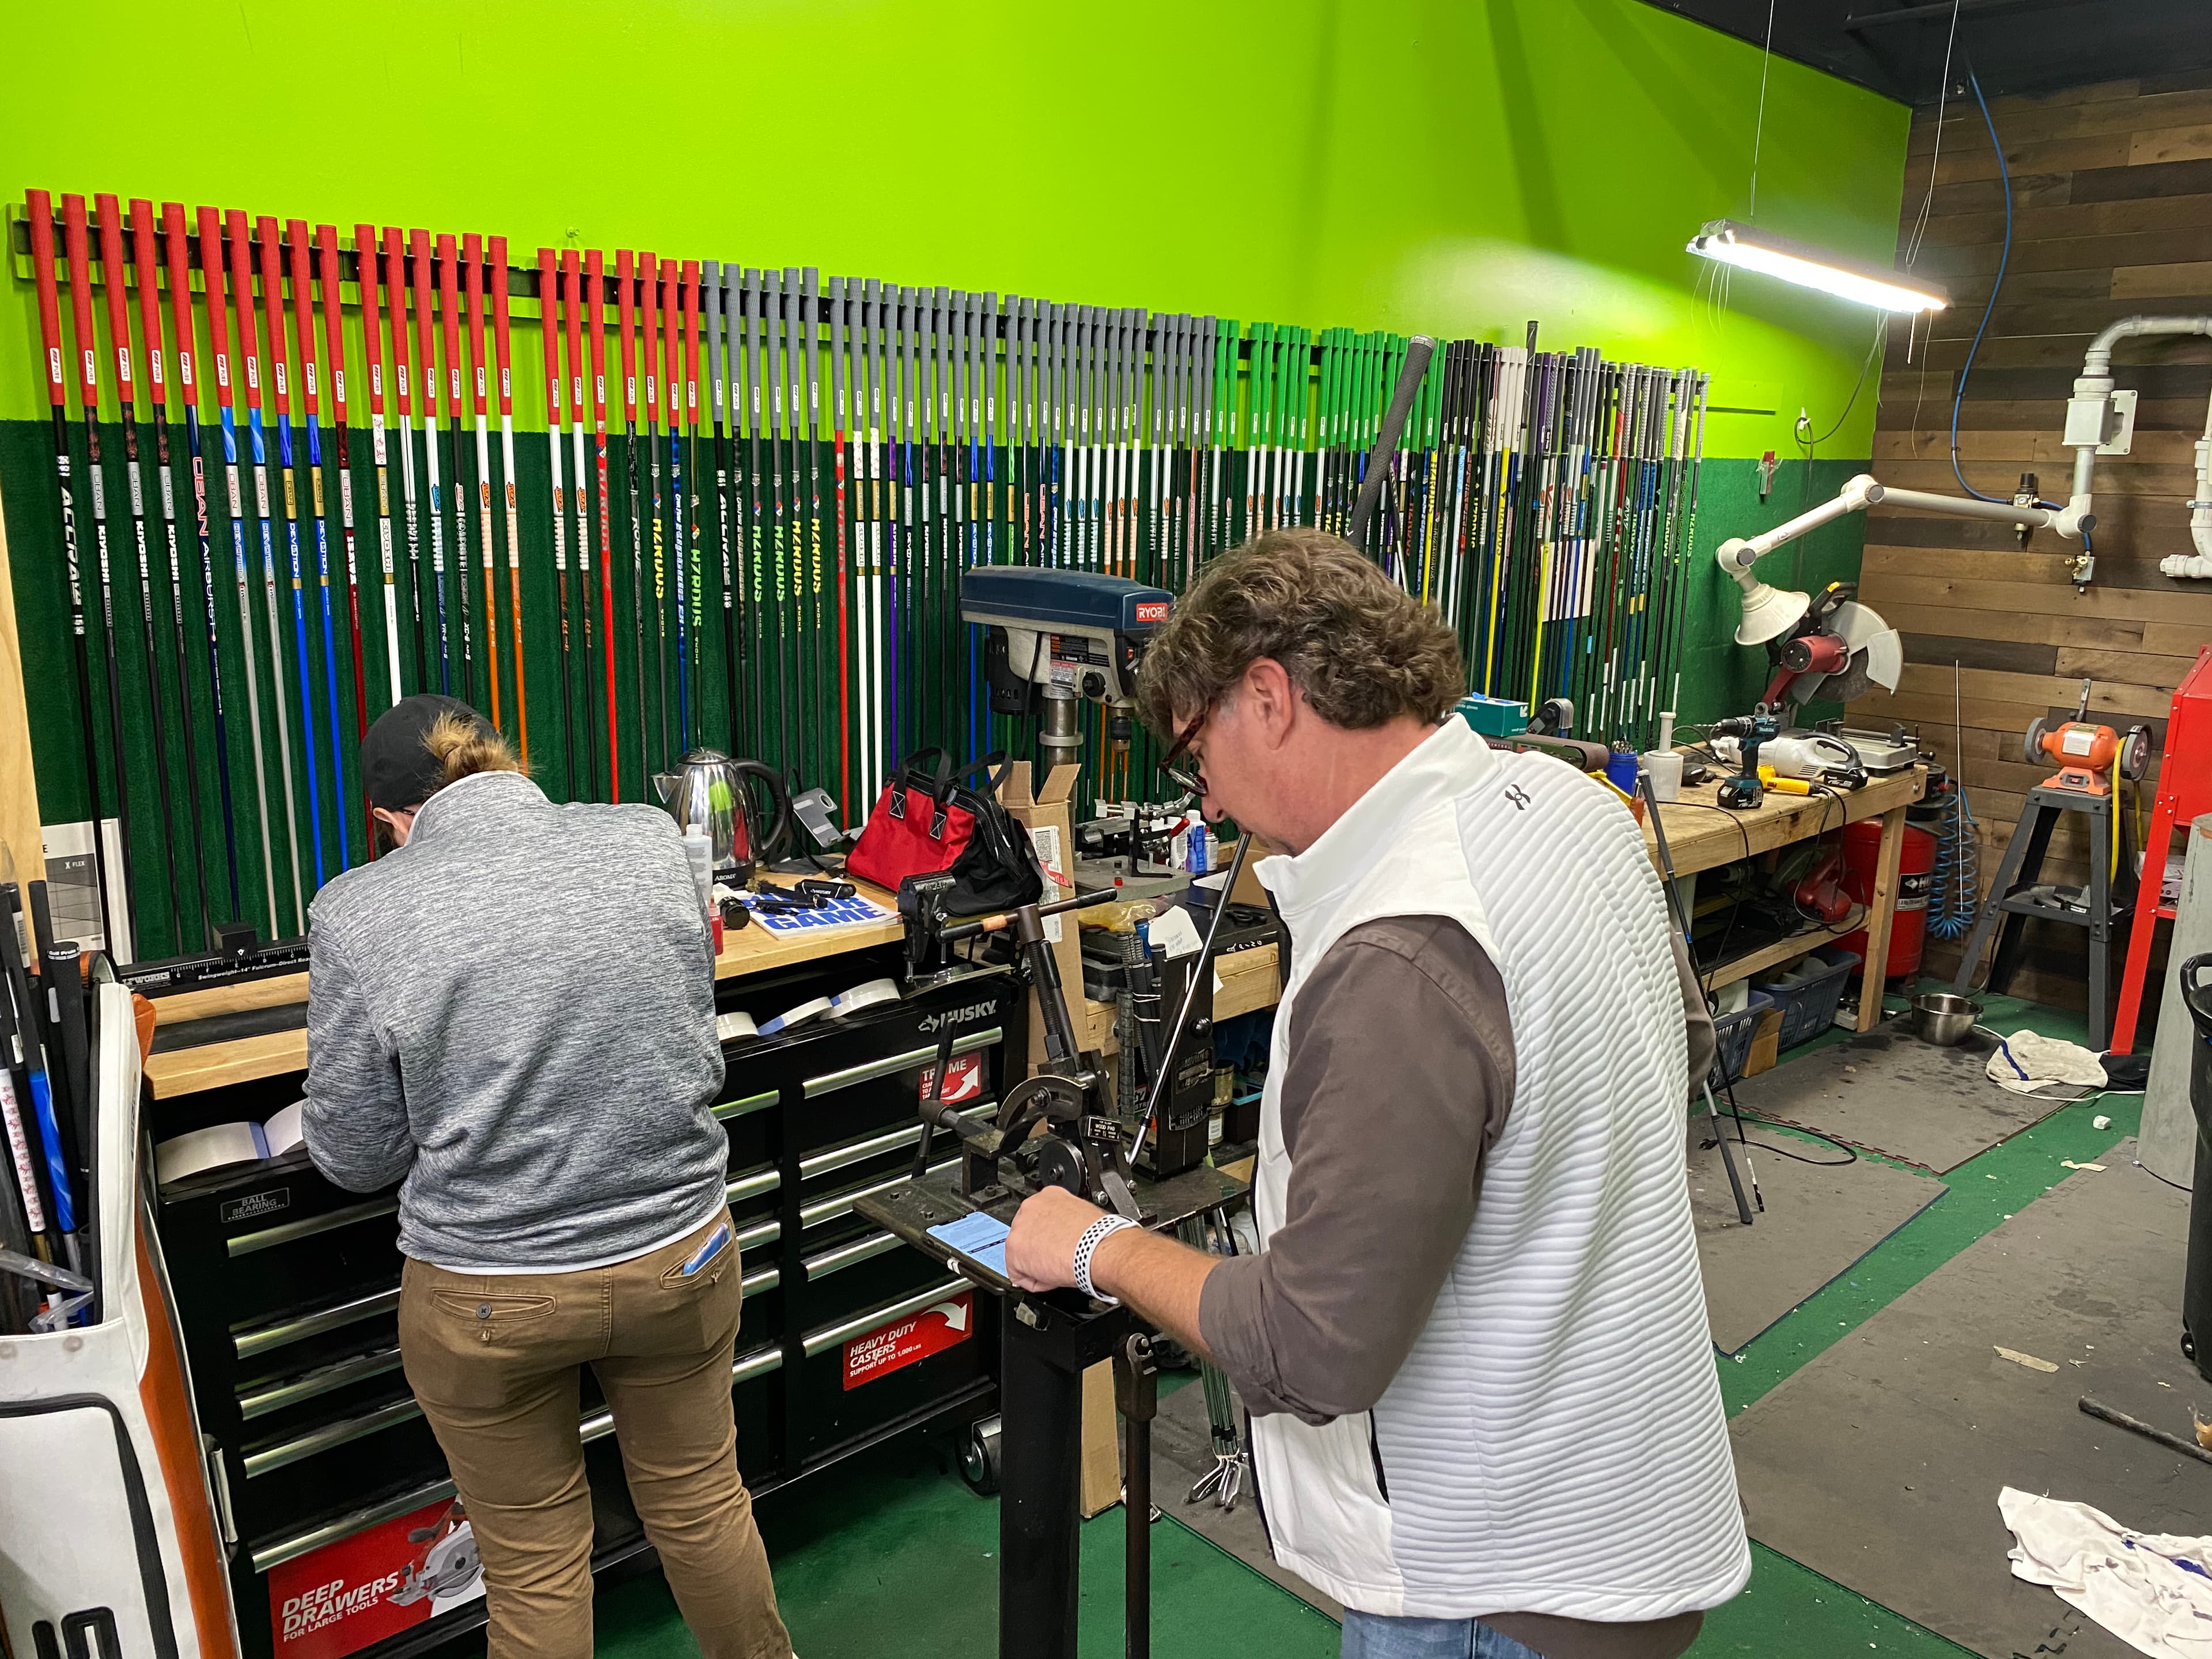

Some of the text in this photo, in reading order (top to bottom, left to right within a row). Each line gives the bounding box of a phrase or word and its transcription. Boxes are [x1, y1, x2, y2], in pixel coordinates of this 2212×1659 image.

[93, 475, 102, 510] OBAN
[131, 471, 140, 507] OBAN
[342, 476, 352, 520] OBAN
[61, 487, 80, 581] ACCRA
[98, 525, 110, 583] KIYOSHI
[136, 521, 149, 578] KIYOSHI
[167, 524, 180, 581] KIYOSHI
[192, 457, 216, 628] OBAN AIRBURST
[233, 524, 245, 579] DEVOTION
[262, 523, 272, 578] DEVOTION
[289, 522, 300, 577] DEVOTION
[319, 521, 327, 574] DEVOTION
[382, 520, 392, 571] KIYOSHI
[631, 517, 642, 577] ROGUE
[653, 518, 664, 599] HZRDUS
[793, 521, 802, 596] HZRDUS
[811, 518, 821, 593] HZRDUS
[691, 549, 702, 627] HZRDUS
[752, 525, 762, 603] HZRDUS
[774, 525, 785, 602] HZRDUS
[1138, 607, 1165, 619] RYOBI
[43, 844, 48, 853] E
[714, 873, 736, 881] AROMA
[764, 906, 887, 930] GAME
[1238, 940, 1263, 950] PING
[922, 1059, 967, 1082] TR ME
[233, 1199, 277, 1216] BEARING
[242, 1194, 267, 1207] BALL
[849, 1361, 877, 1377] SUPPORT
[878, 1357, 887, 1366] UP
[897, 1347, 913, 1358] 1,000
[850, 1321, 917, 1357] HEAVY DUTY
[850, 1341, 896, 1369] CASTERS
[282, 1580, 344, 1618] DEEP
[283, 1571, 399, 1634] DRAWERS
[284, 1596, 378, 1642] FOR LARGE TOOLS
